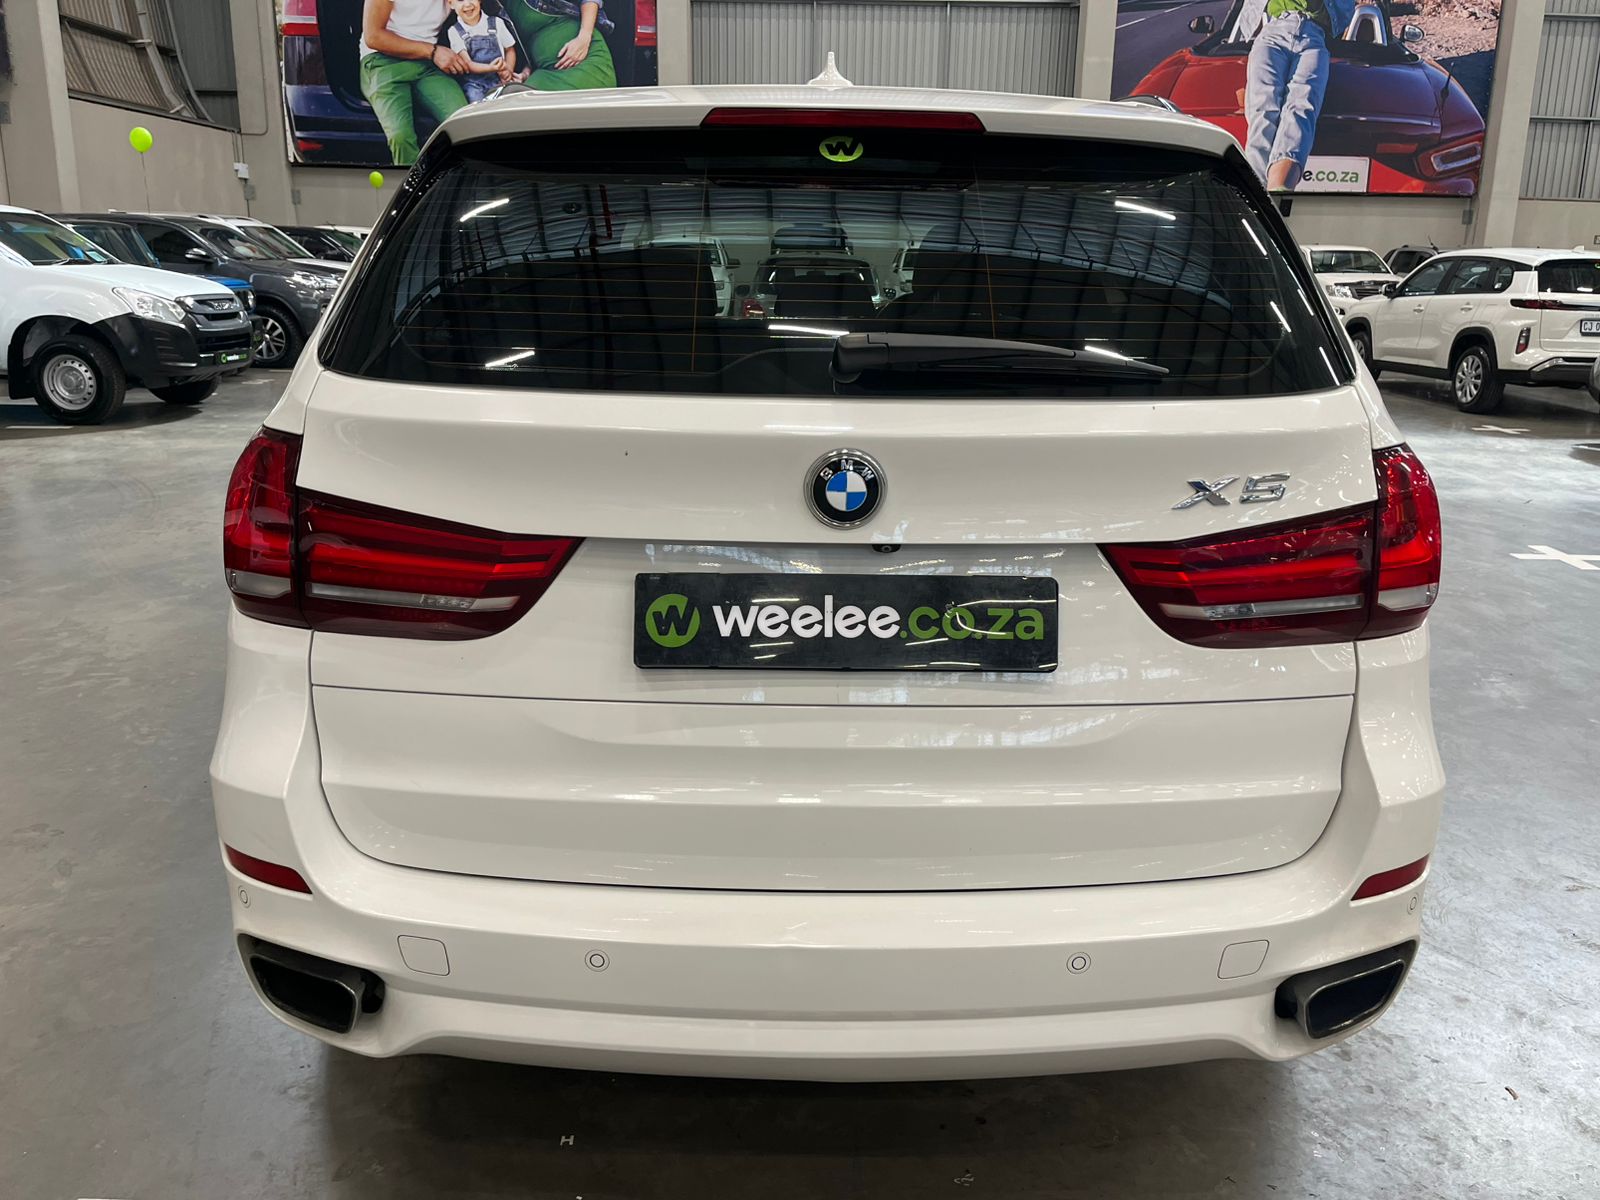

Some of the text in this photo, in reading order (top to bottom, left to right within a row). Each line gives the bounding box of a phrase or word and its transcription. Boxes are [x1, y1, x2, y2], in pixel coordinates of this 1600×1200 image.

[820, 459, 874, 480] BMW
[1171, 471, 1291, 510] X5
[712, 594, 1044, 640] weelee.co.za
